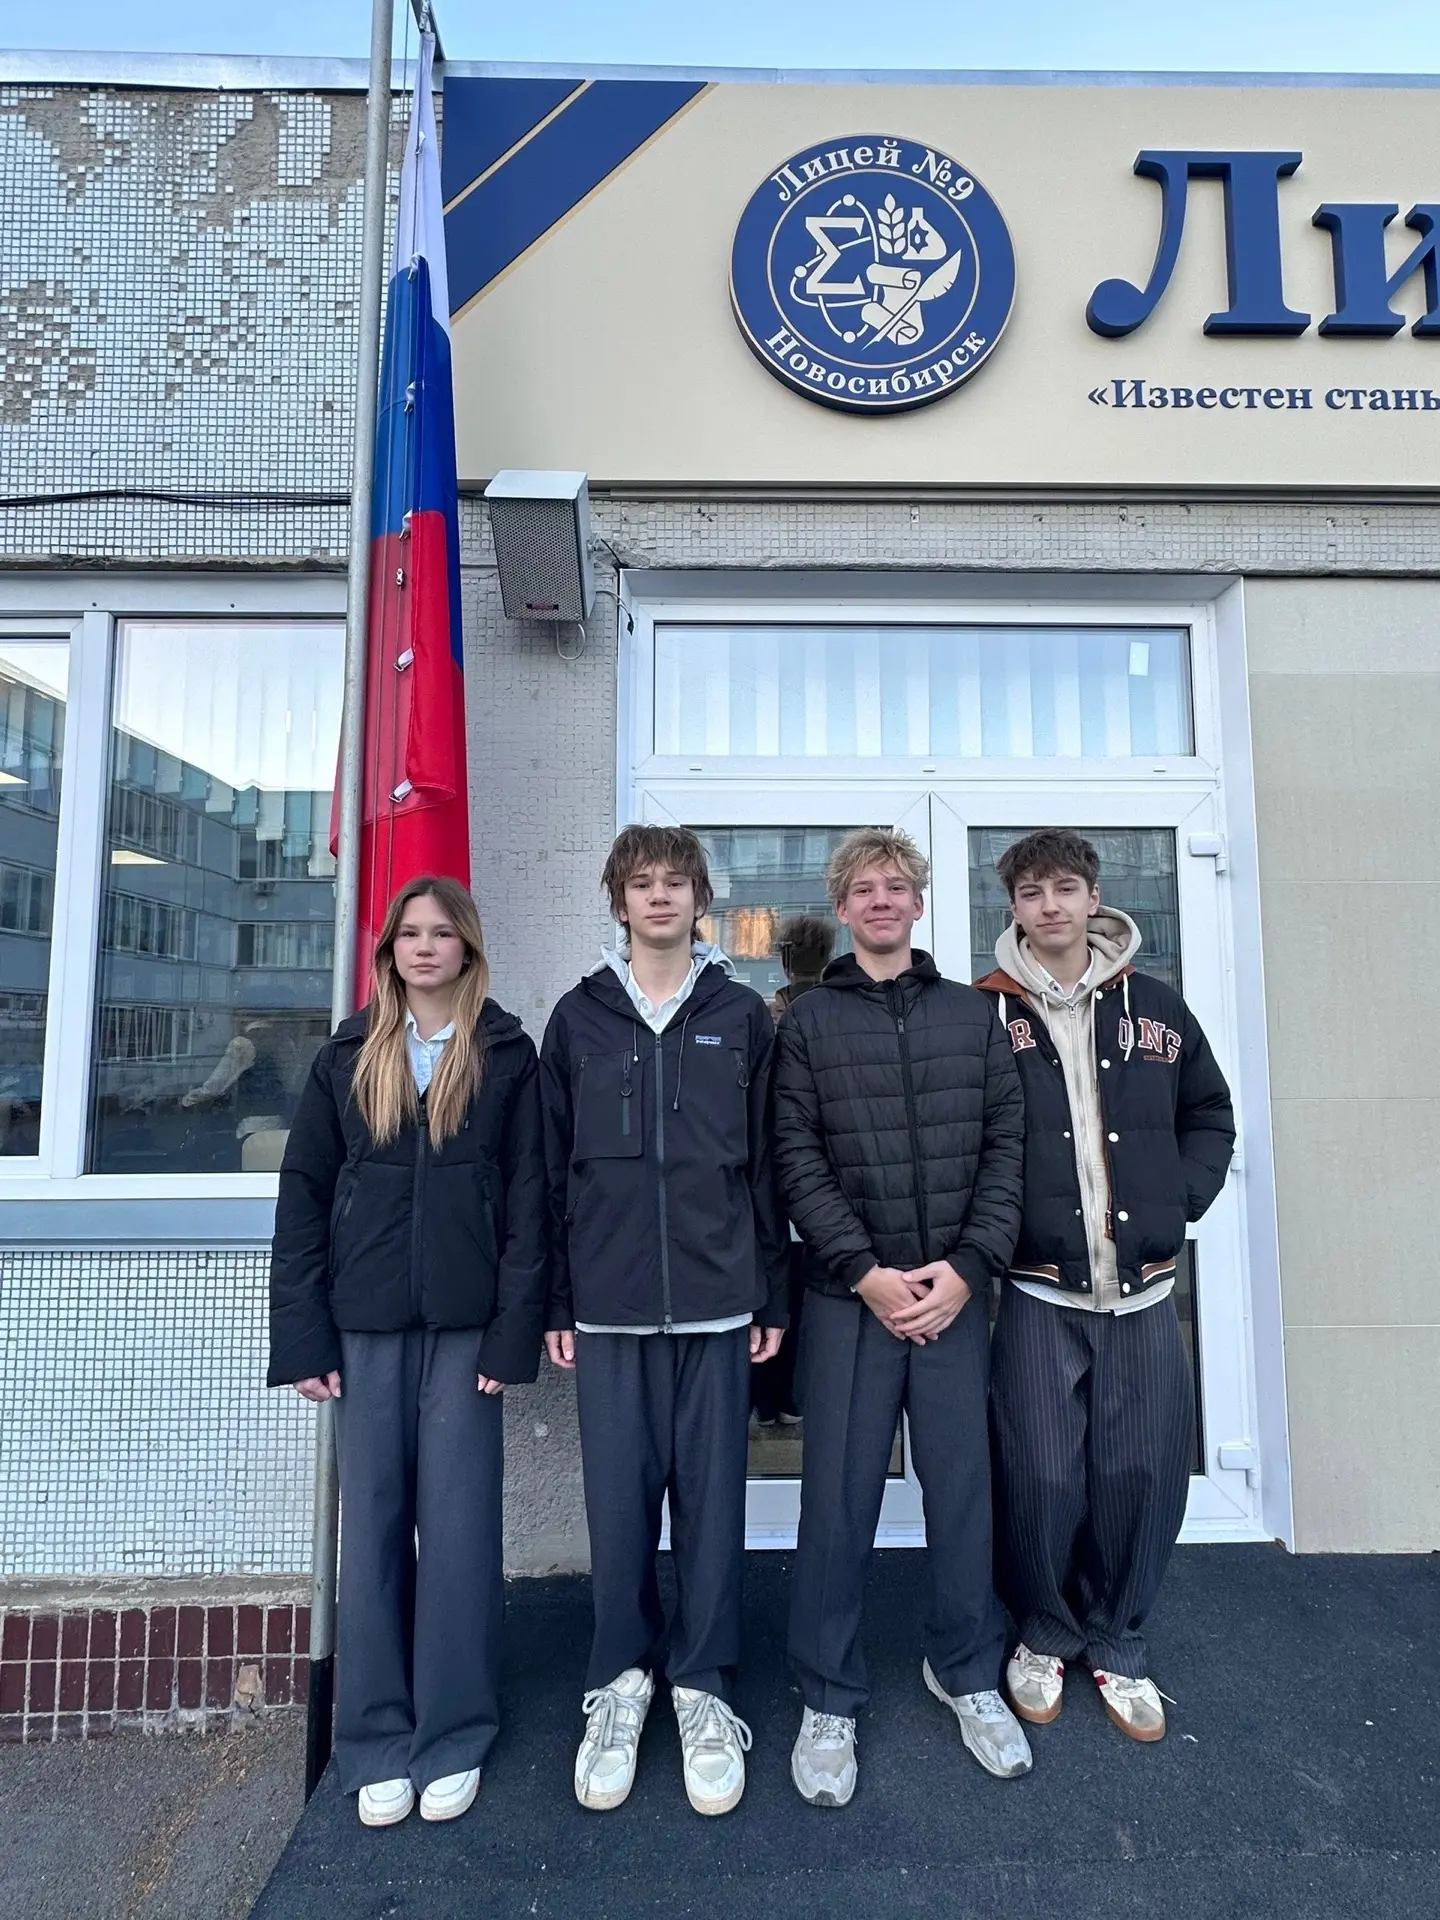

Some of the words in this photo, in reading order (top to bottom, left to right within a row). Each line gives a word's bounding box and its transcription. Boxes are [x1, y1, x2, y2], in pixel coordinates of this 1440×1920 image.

[770, 139, 902, 201] Лицей
[912, 149, 975, 201] №9
[1085, 150, 1440, 338] Ли
[764, 326, 986, 395] Новосибирск
[1088, 379, 1313, 411] «Известен
